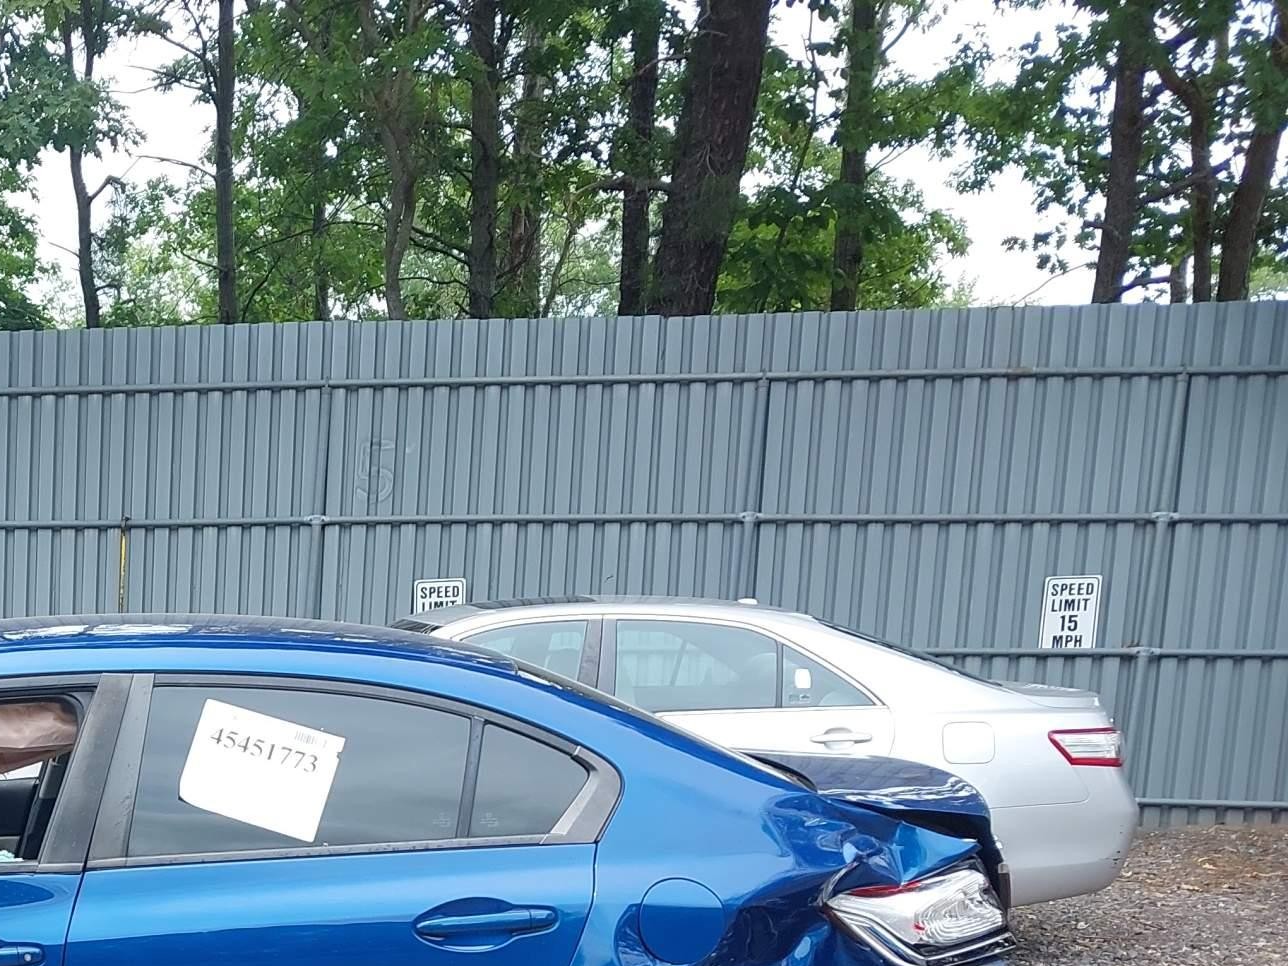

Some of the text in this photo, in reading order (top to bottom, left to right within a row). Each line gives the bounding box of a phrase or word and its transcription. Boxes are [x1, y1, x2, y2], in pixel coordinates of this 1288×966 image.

[420, 585, 460, 599] SPEED
[1051, 583, 1095, 597] SPEED
[1051, 598, 1091, 612] LIMIT
[1060, 614, 1079, 632] 15
[1052, 635, 1083, 649] MPH
[210, 727, 319, 773] 45451773
